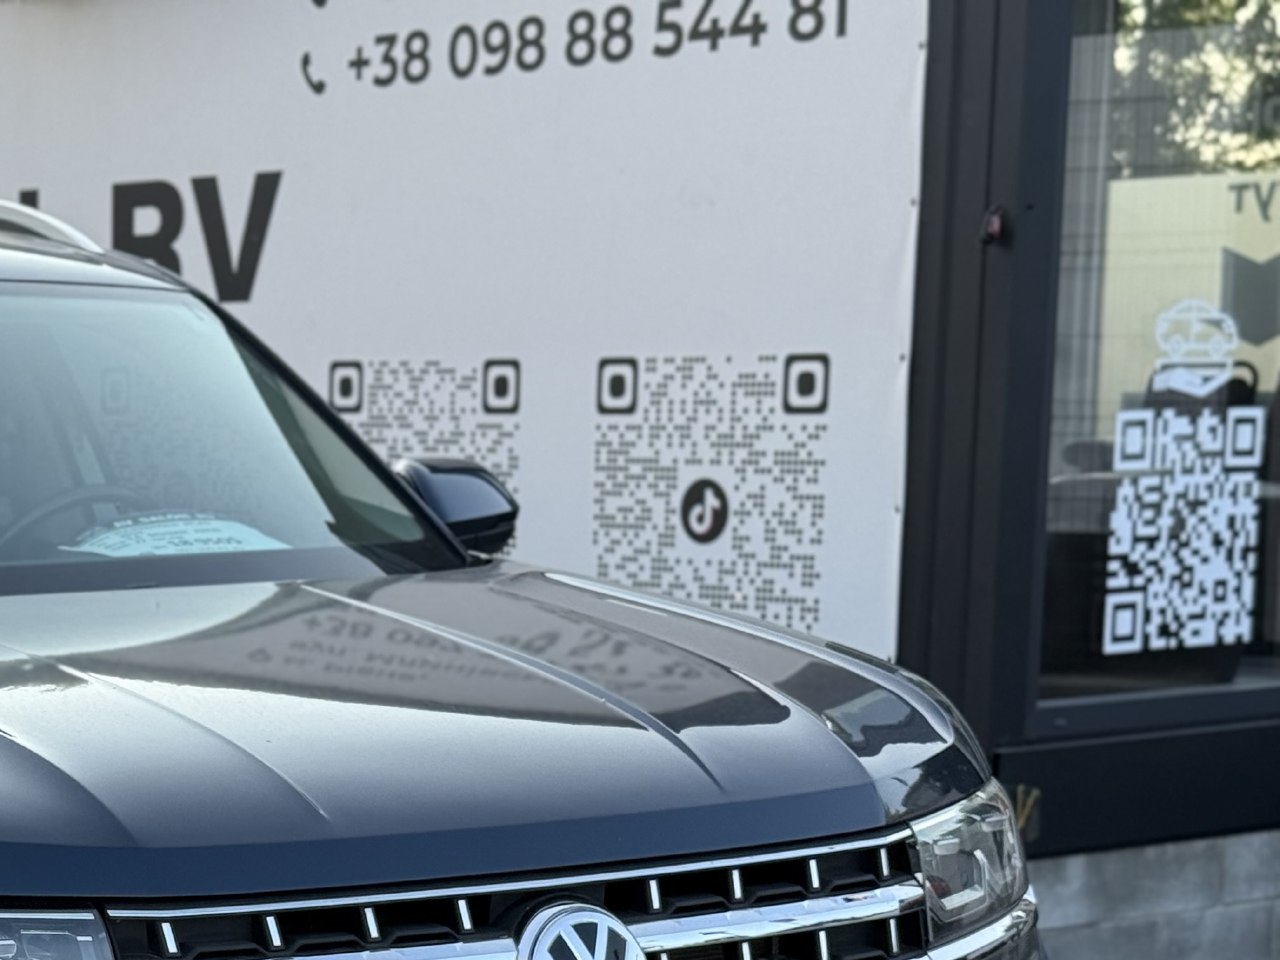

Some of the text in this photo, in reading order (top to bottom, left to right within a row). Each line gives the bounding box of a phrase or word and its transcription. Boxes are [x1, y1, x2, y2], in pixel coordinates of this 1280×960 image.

[348, 0, 848, 87] +38 098 88 544 81
[112, 169, 283, 303] RV
